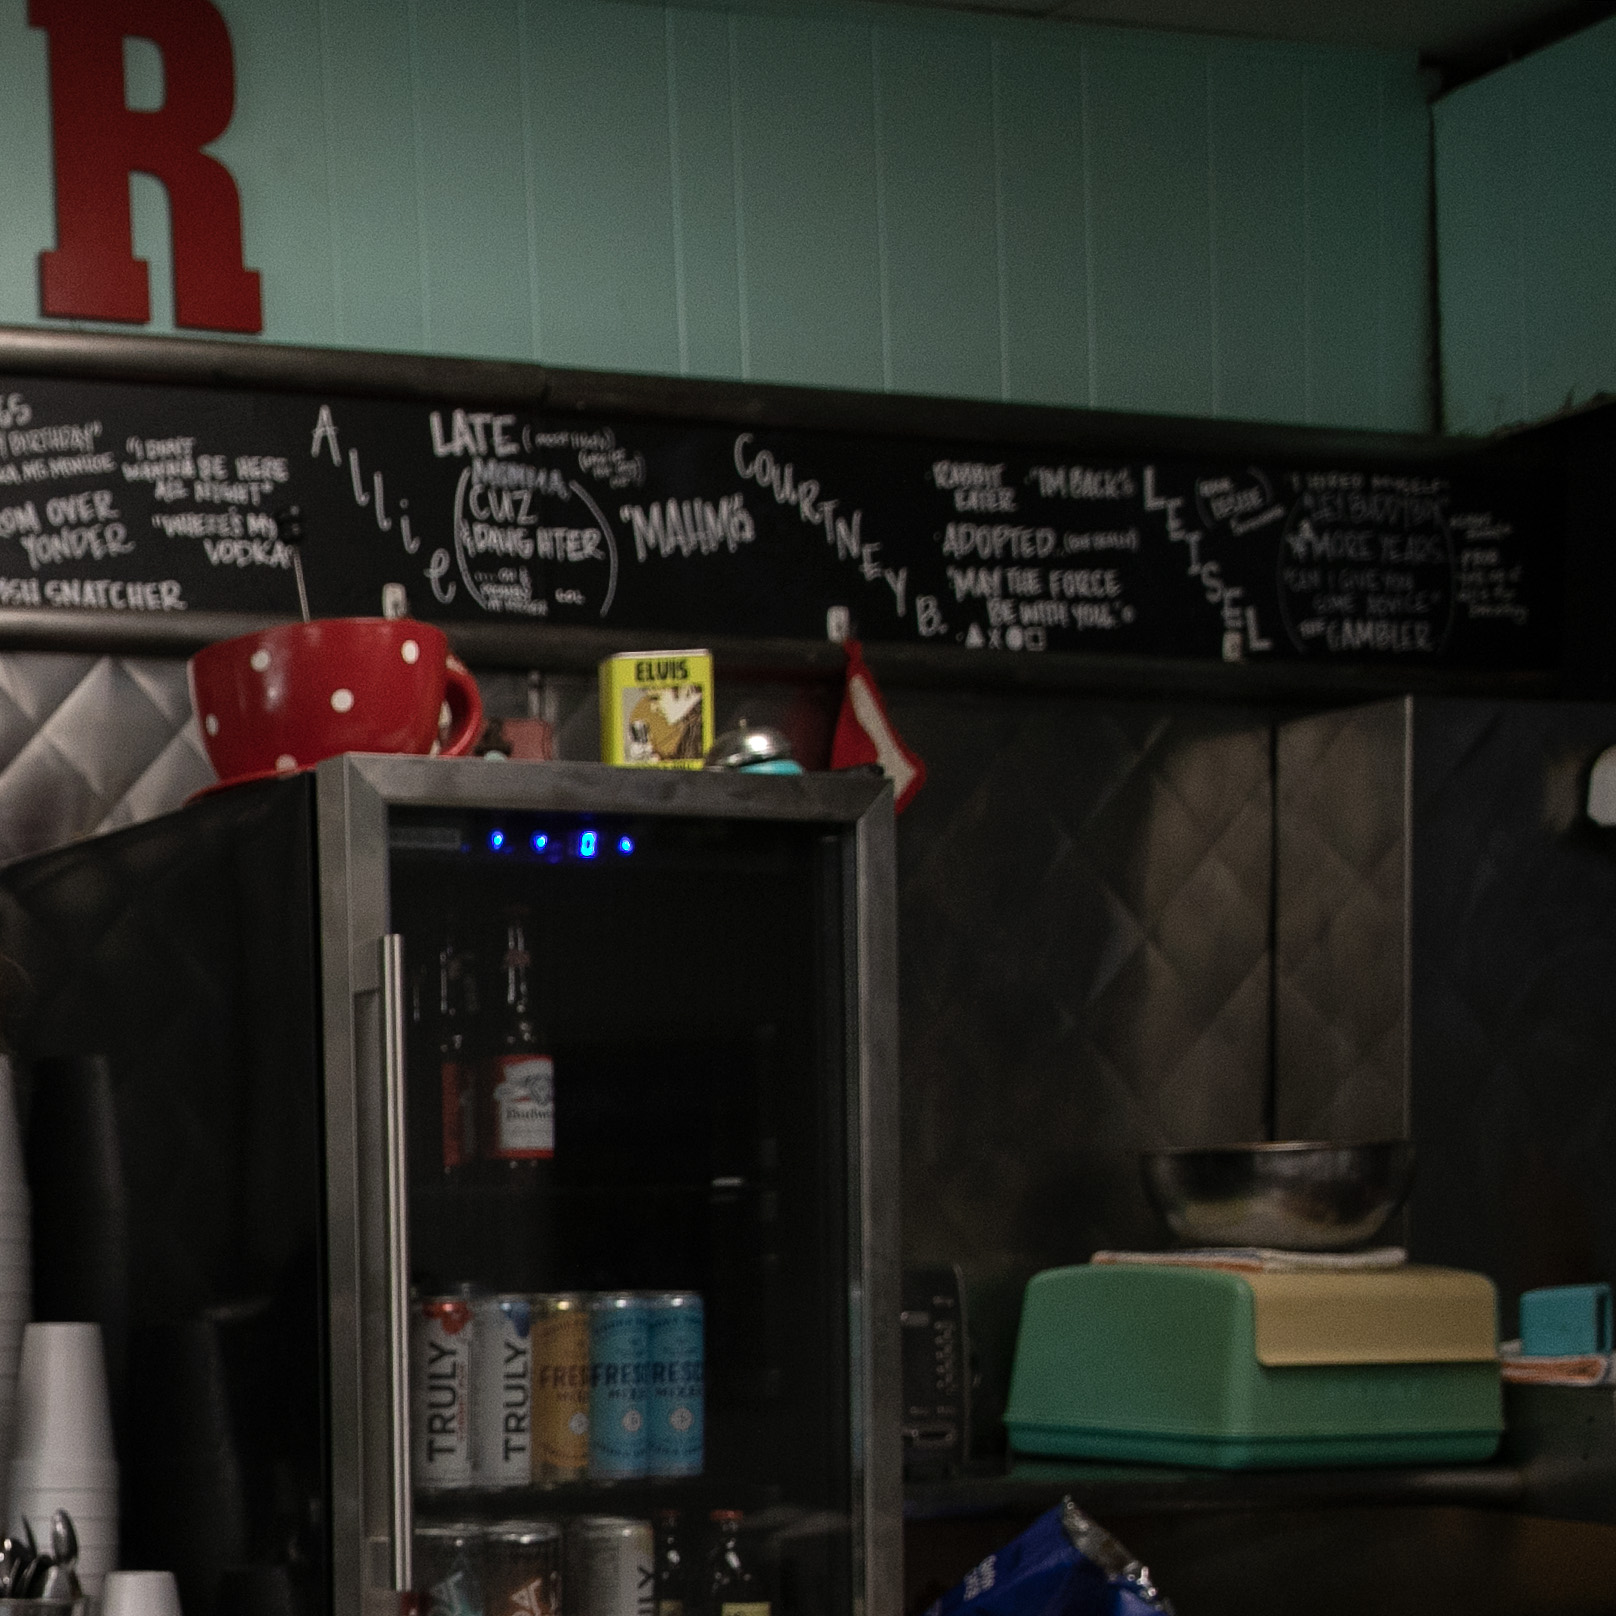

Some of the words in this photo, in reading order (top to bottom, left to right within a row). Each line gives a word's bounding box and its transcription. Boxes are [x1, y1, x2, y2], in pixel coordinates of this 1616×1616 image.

[429, 408, 521, 458] LATE
[45, 489, 122, 528] OVER
[469, 483, 539, 526] CUZ
[19, 521, 137, 572] YONDER
[43, 578, 190, 612] SNATCHER
[634, 660, 689, 682] ELVIS
[428, 1341, 458, 1463] TRULY
[503, 1341, 529, 1462] TRULY
